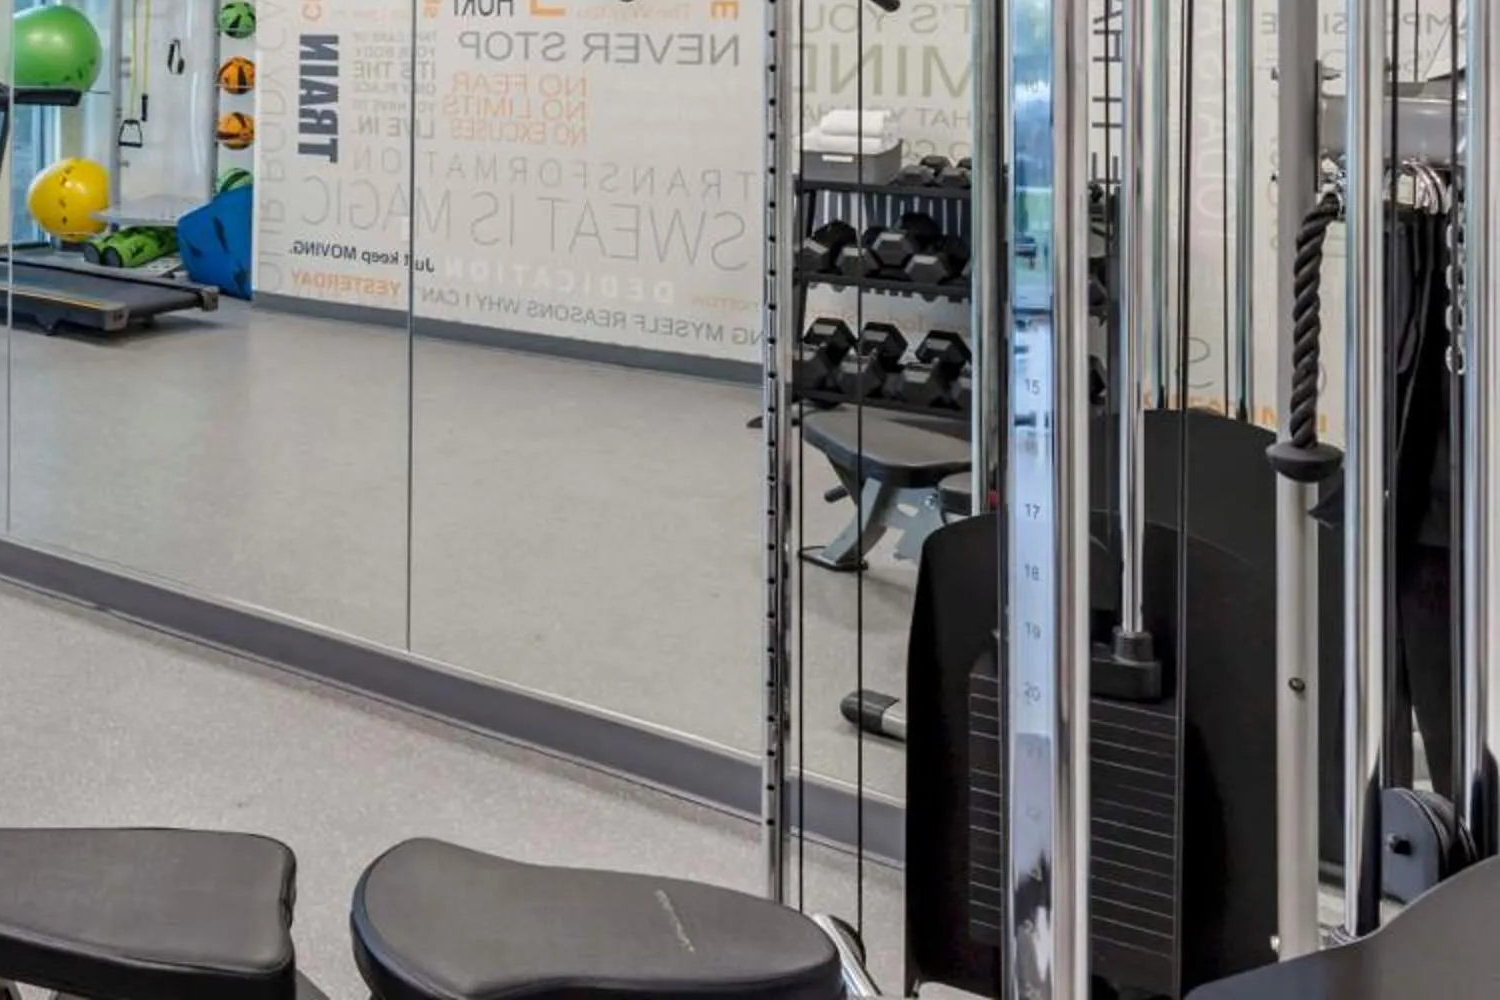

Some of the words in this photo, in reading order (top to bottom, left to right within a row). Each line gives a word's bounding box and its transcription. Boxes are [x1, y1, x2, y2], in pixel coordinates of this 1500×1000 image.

[1024, 378, 1041, 396] 15
[1024, 503, 1041, 520] 17
[1024, 621, 1042, 640] 19
